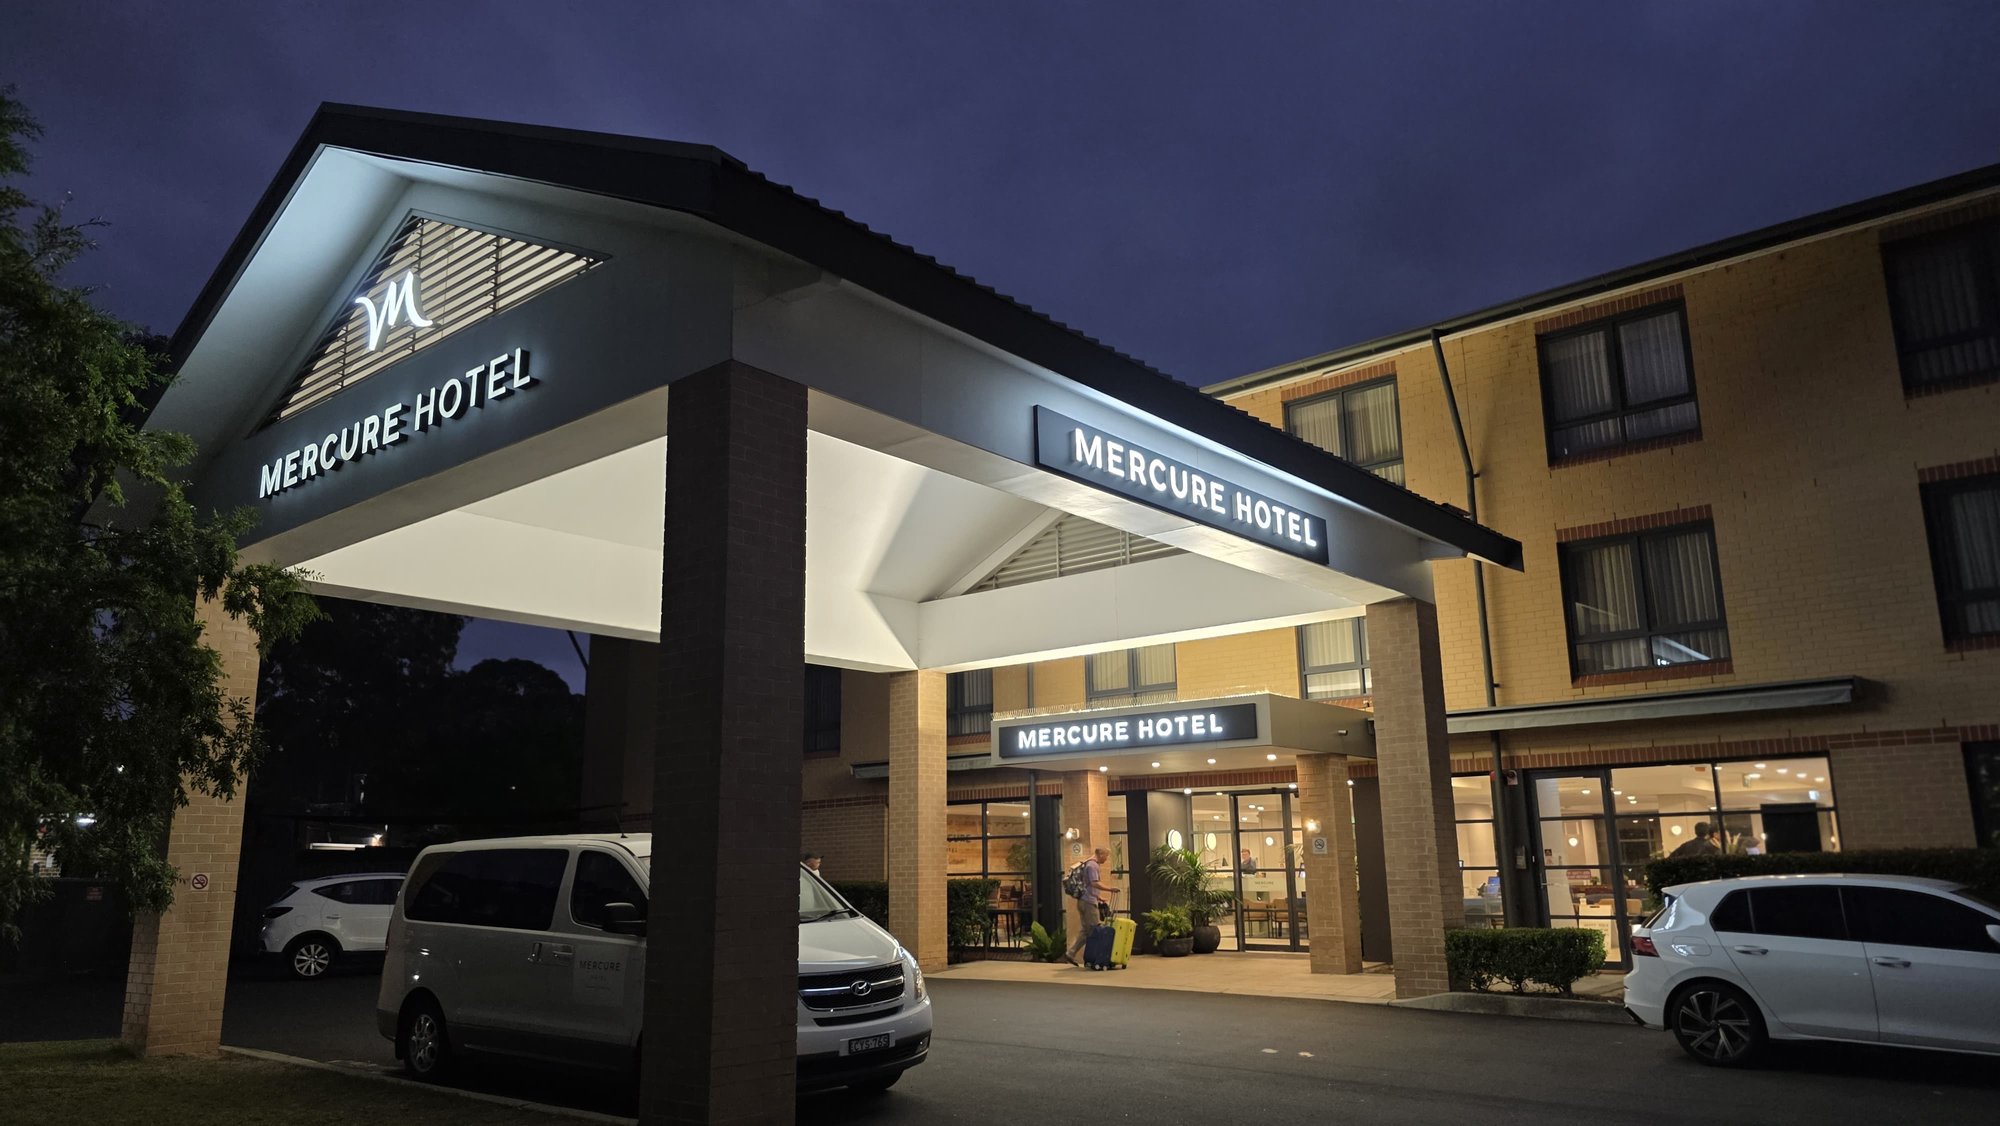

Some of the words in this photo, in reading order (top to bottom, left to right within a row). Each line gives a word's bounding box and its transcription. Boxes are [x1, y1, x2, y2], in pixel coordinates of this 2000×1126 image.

[259, 402, 403, 499] MERCURE
[414, 347, 531, 432] HOTEL
[1074, 427, 1226, 515] MERCURE
[1236, 491, 1317, 547] HOTEL
[1018, 721, 1129, 749] MERCURE
[1138, 714, 1223, 740] HOTEL
[579, 960, 621, 971] MERCURE
